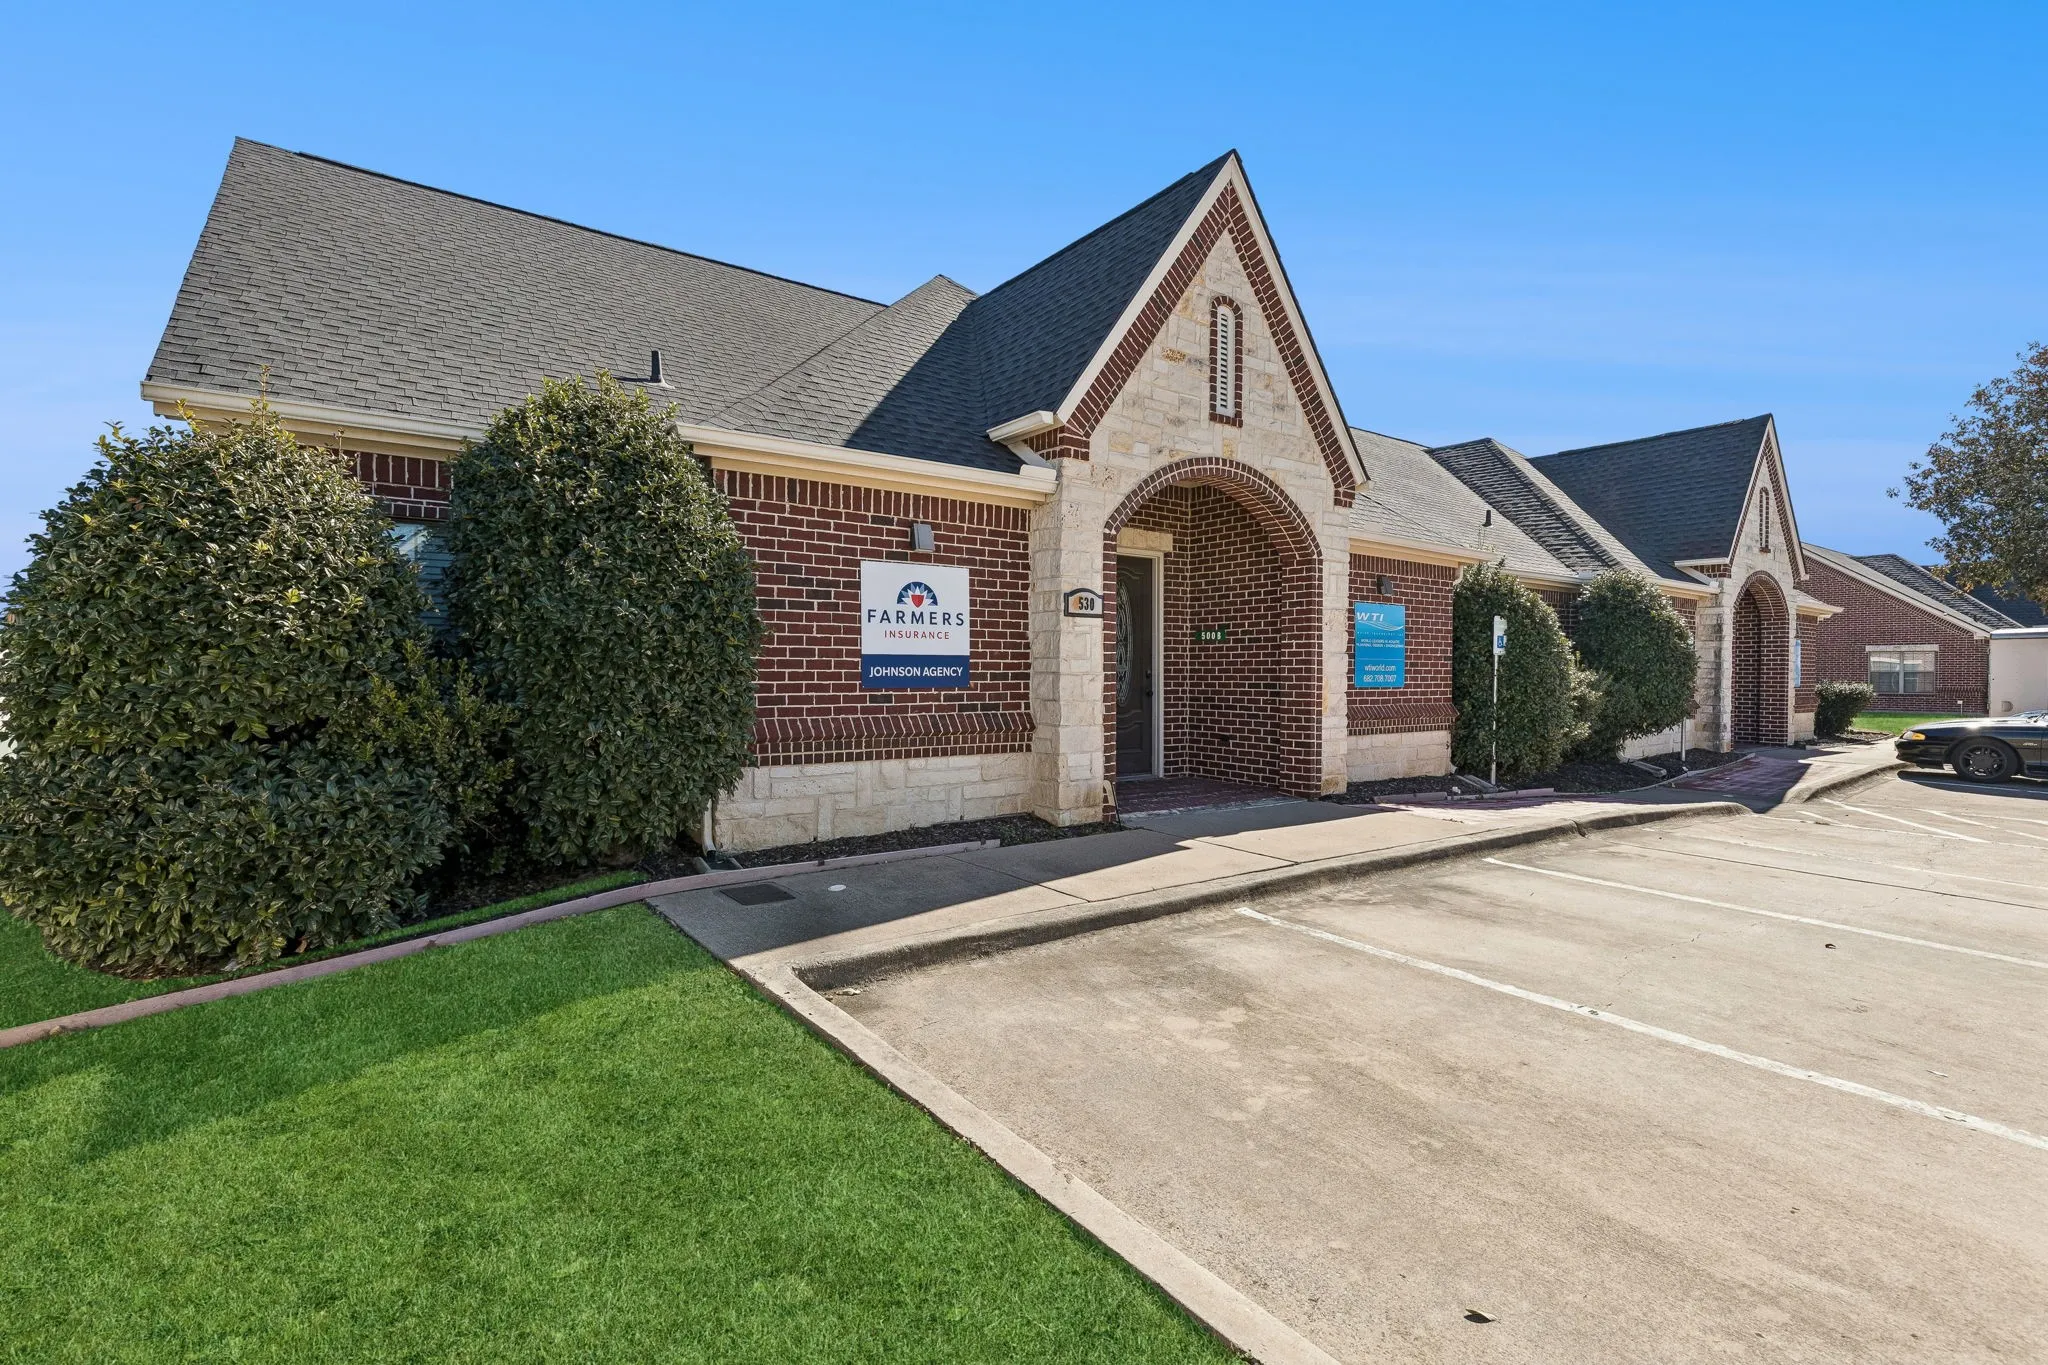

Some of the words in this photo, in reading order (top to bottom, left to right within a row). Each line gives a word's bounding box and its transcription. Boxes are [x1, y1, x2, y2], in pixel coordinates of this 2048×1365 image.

[1078, 596, 1095, 611] 530
[867, 609, 964, 626] FARMERS
[1356, 612, 1384, 621] WTI
[884, 630, 950, 639] INSURANCE
[869, 666, 921, 678] JOHNSON
[922, 666, 963, 677] AGENCY
